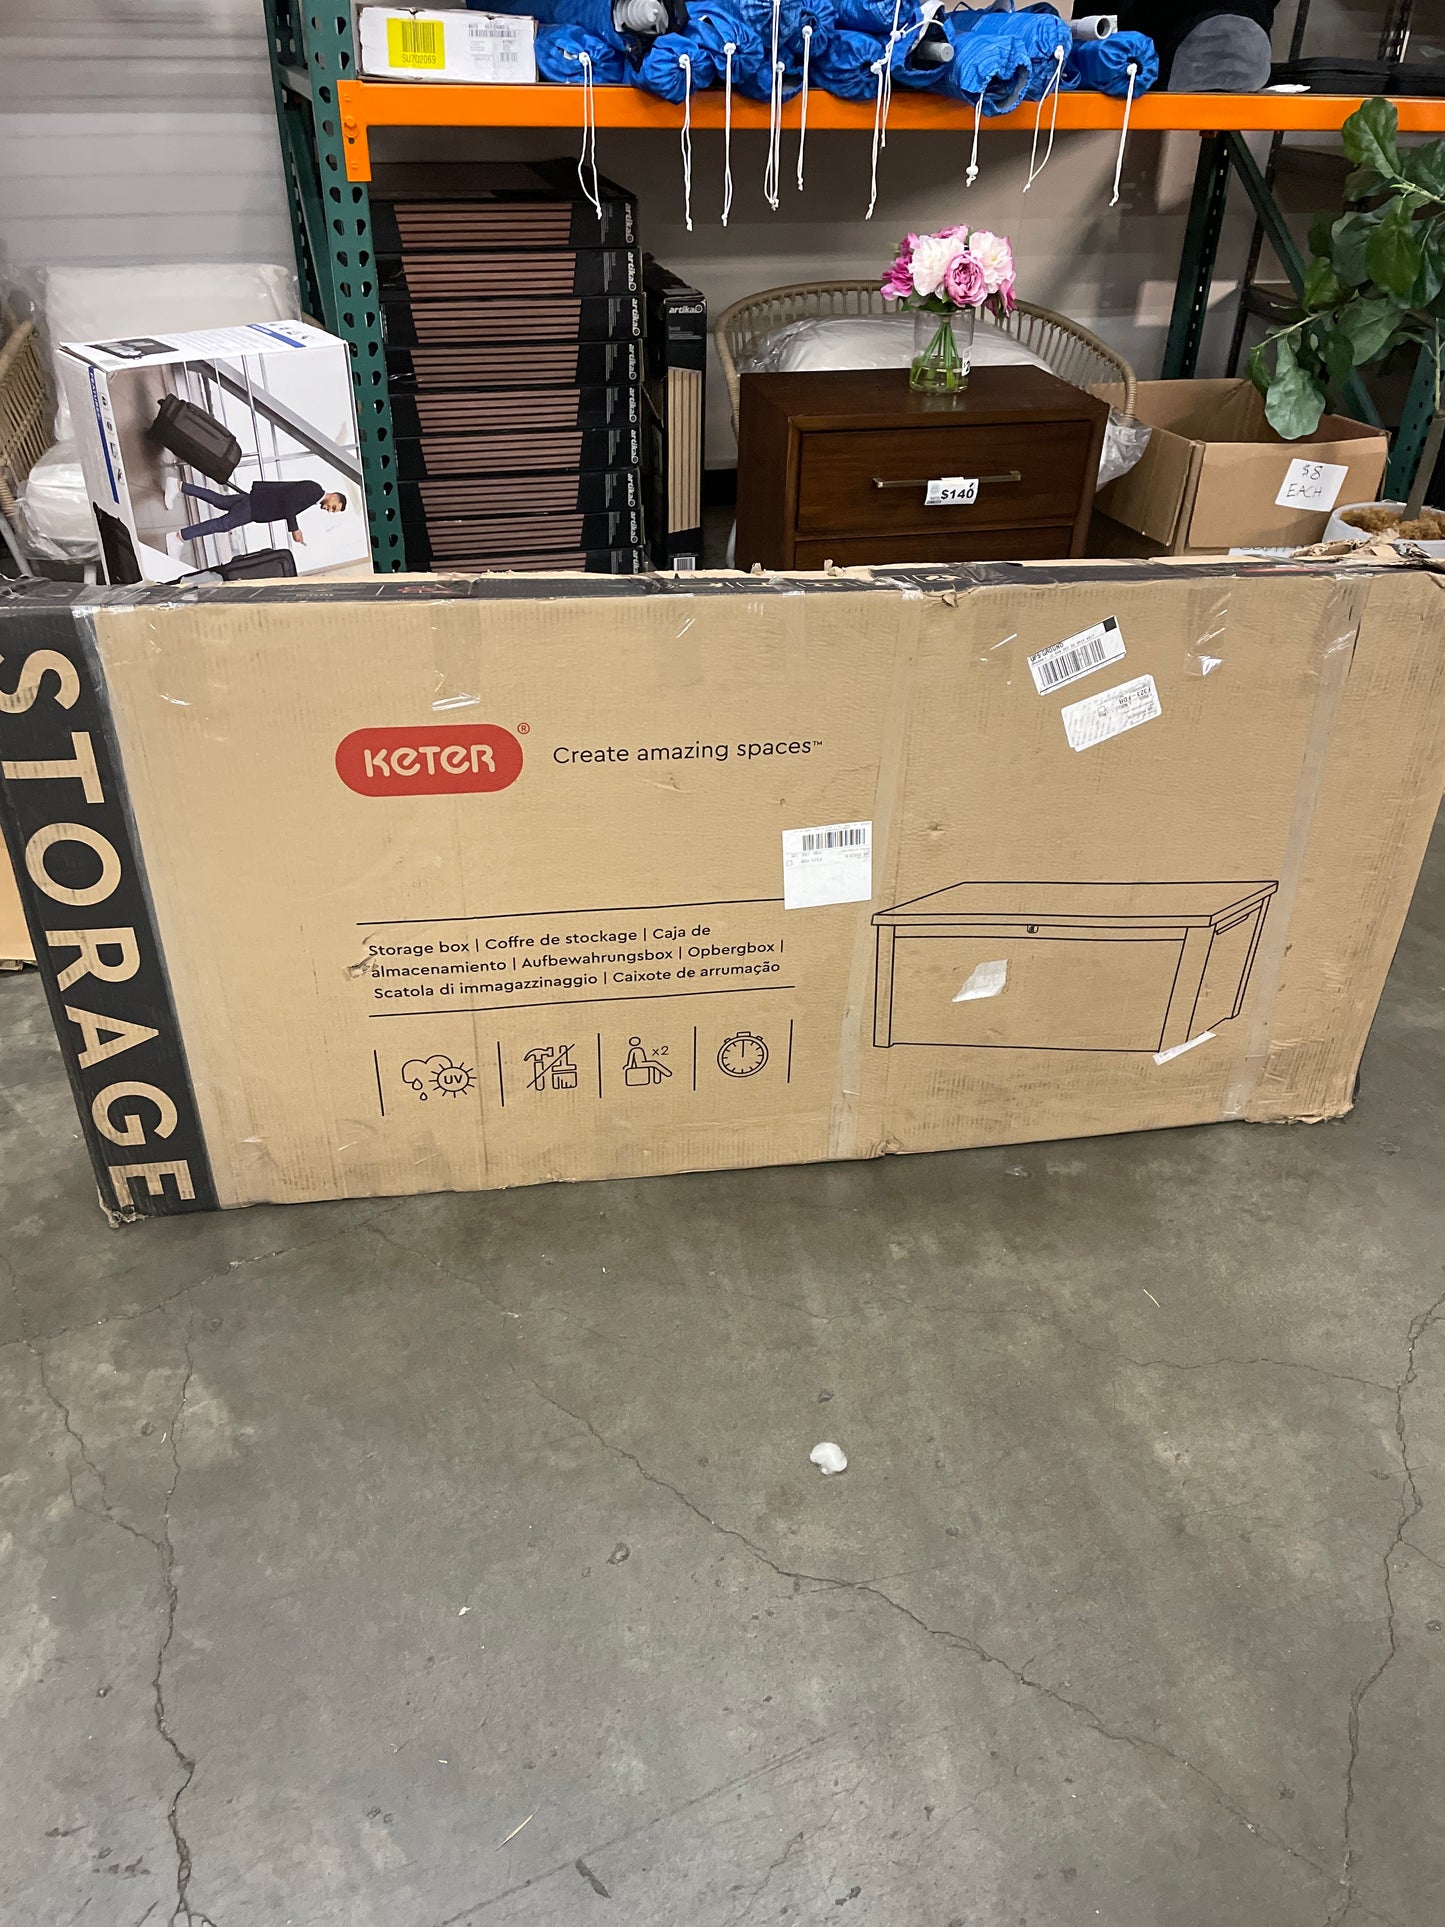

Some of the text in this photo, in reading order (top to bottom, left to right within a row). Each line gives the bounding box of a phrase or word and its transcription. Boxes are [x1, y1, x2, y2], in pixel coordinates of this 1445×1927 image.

[402, 53, 437, 65] SU702069
[669, 305, 696, 314] artika
[1302, 464, 1323, 480] $8
[1286, 483, 1322, 498] EACH
[553, 746, 630, 764] Create
[637, 740, 729, 762] amazing
[0, 649, 196, 1208] STORAGE
[369, 924, 711, 957] Storage box Coffre de stockage Caja de
[371, 942, 775, 978] almacenamiento Aufbewahrungsbox Opbergbox
[374, 961, 780, 999] Scatola di immagazzinaggio Caixote de arrumação
[652, 1045, 669, 1057] x2
[444, 1074, 463, 1085] UV
